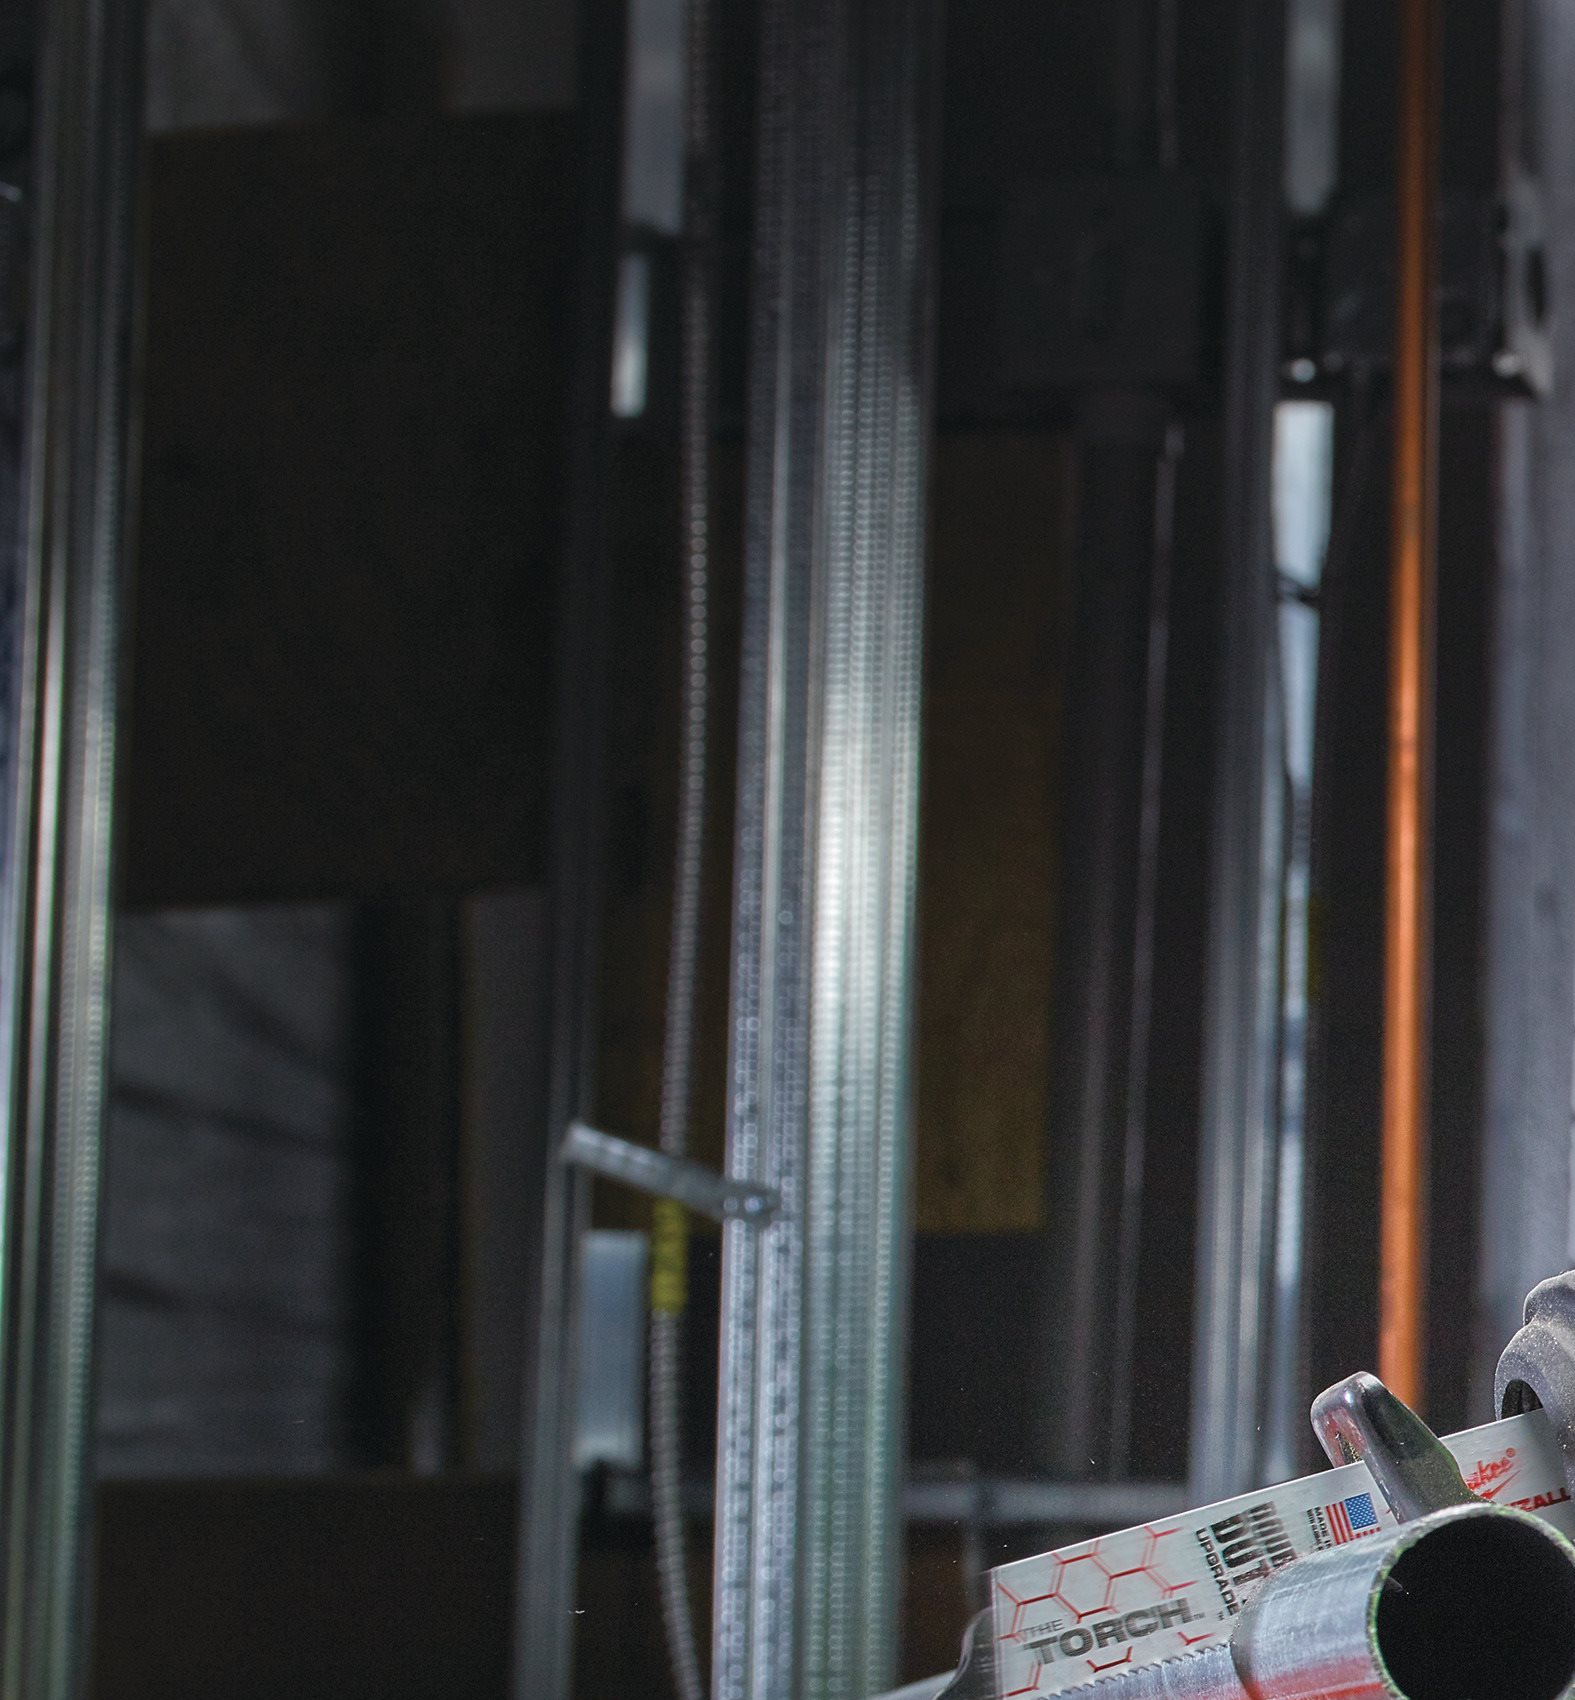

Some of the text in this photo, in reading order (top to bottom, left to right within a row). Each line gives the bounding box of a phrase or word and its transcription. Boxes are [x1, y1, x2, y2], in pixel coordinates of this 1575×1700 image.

[1210, 1512, 1270, 1587] DUT
[1246, 1501, 1297, 1568] DOUB
[1314, 1506, 1329, 1537] MADE
[1196, 1528, 1241, 1616] UPGRADE
[1020, 1619, 1065, 1638] THE
[1024, 1597, 1193, 1664] TORCH
